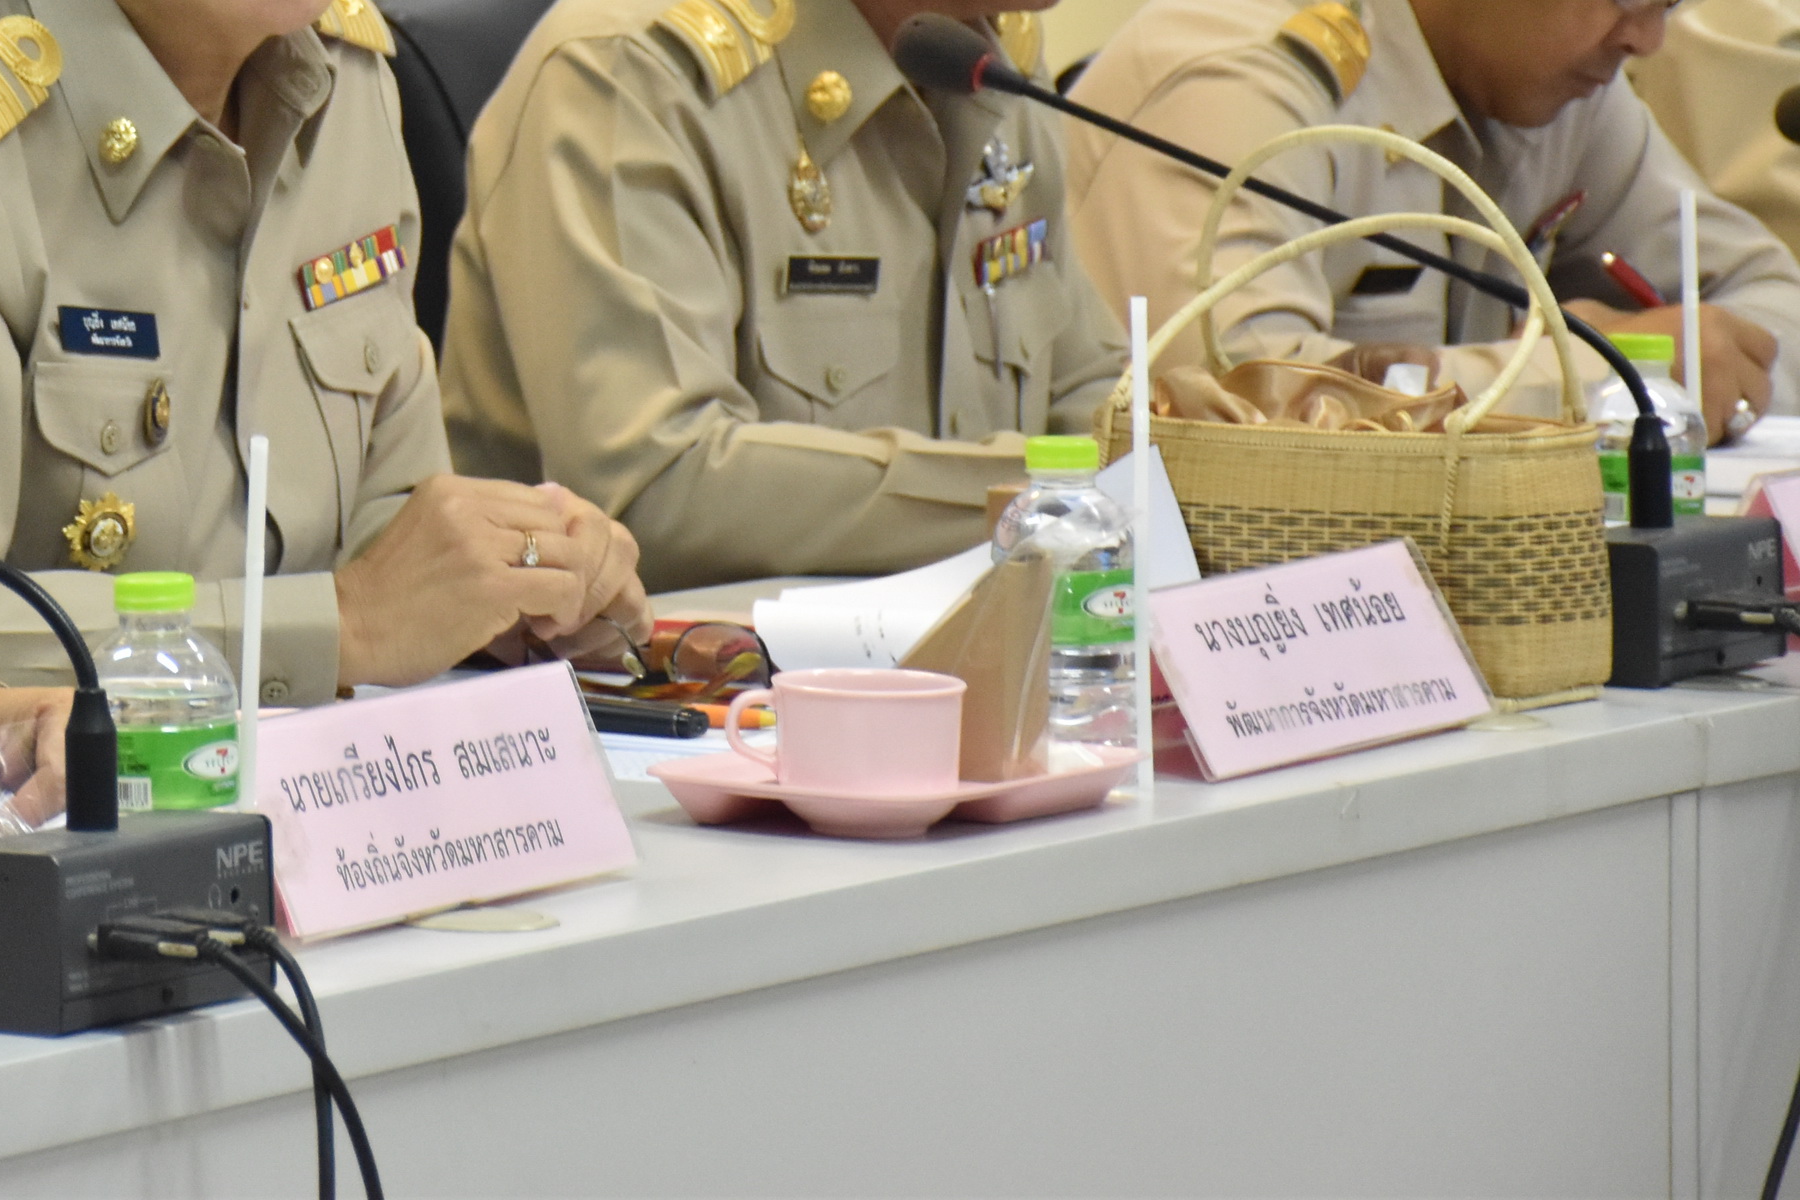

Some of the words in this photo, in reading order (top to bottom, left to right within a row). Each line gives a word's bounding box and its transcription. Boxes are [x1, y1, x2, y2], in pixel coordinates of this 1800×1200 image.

[1195, 582, 1308, 660] นางบุญยิ่ง
[1313, 578, 1406, 632] เทศน้อย
[1226, 678, 1457, 739] พัฒนาการจังหวัดมหาสารคาม
[281, 735, 440, 812] นายเกรียงไกร
[453, 728, 556, 779] สมเสนาะ
[216, 840, 264, 871] NPE
[336, 818, 565, 891] ท้องถิ่นจังหวัดมหาสารคาม
